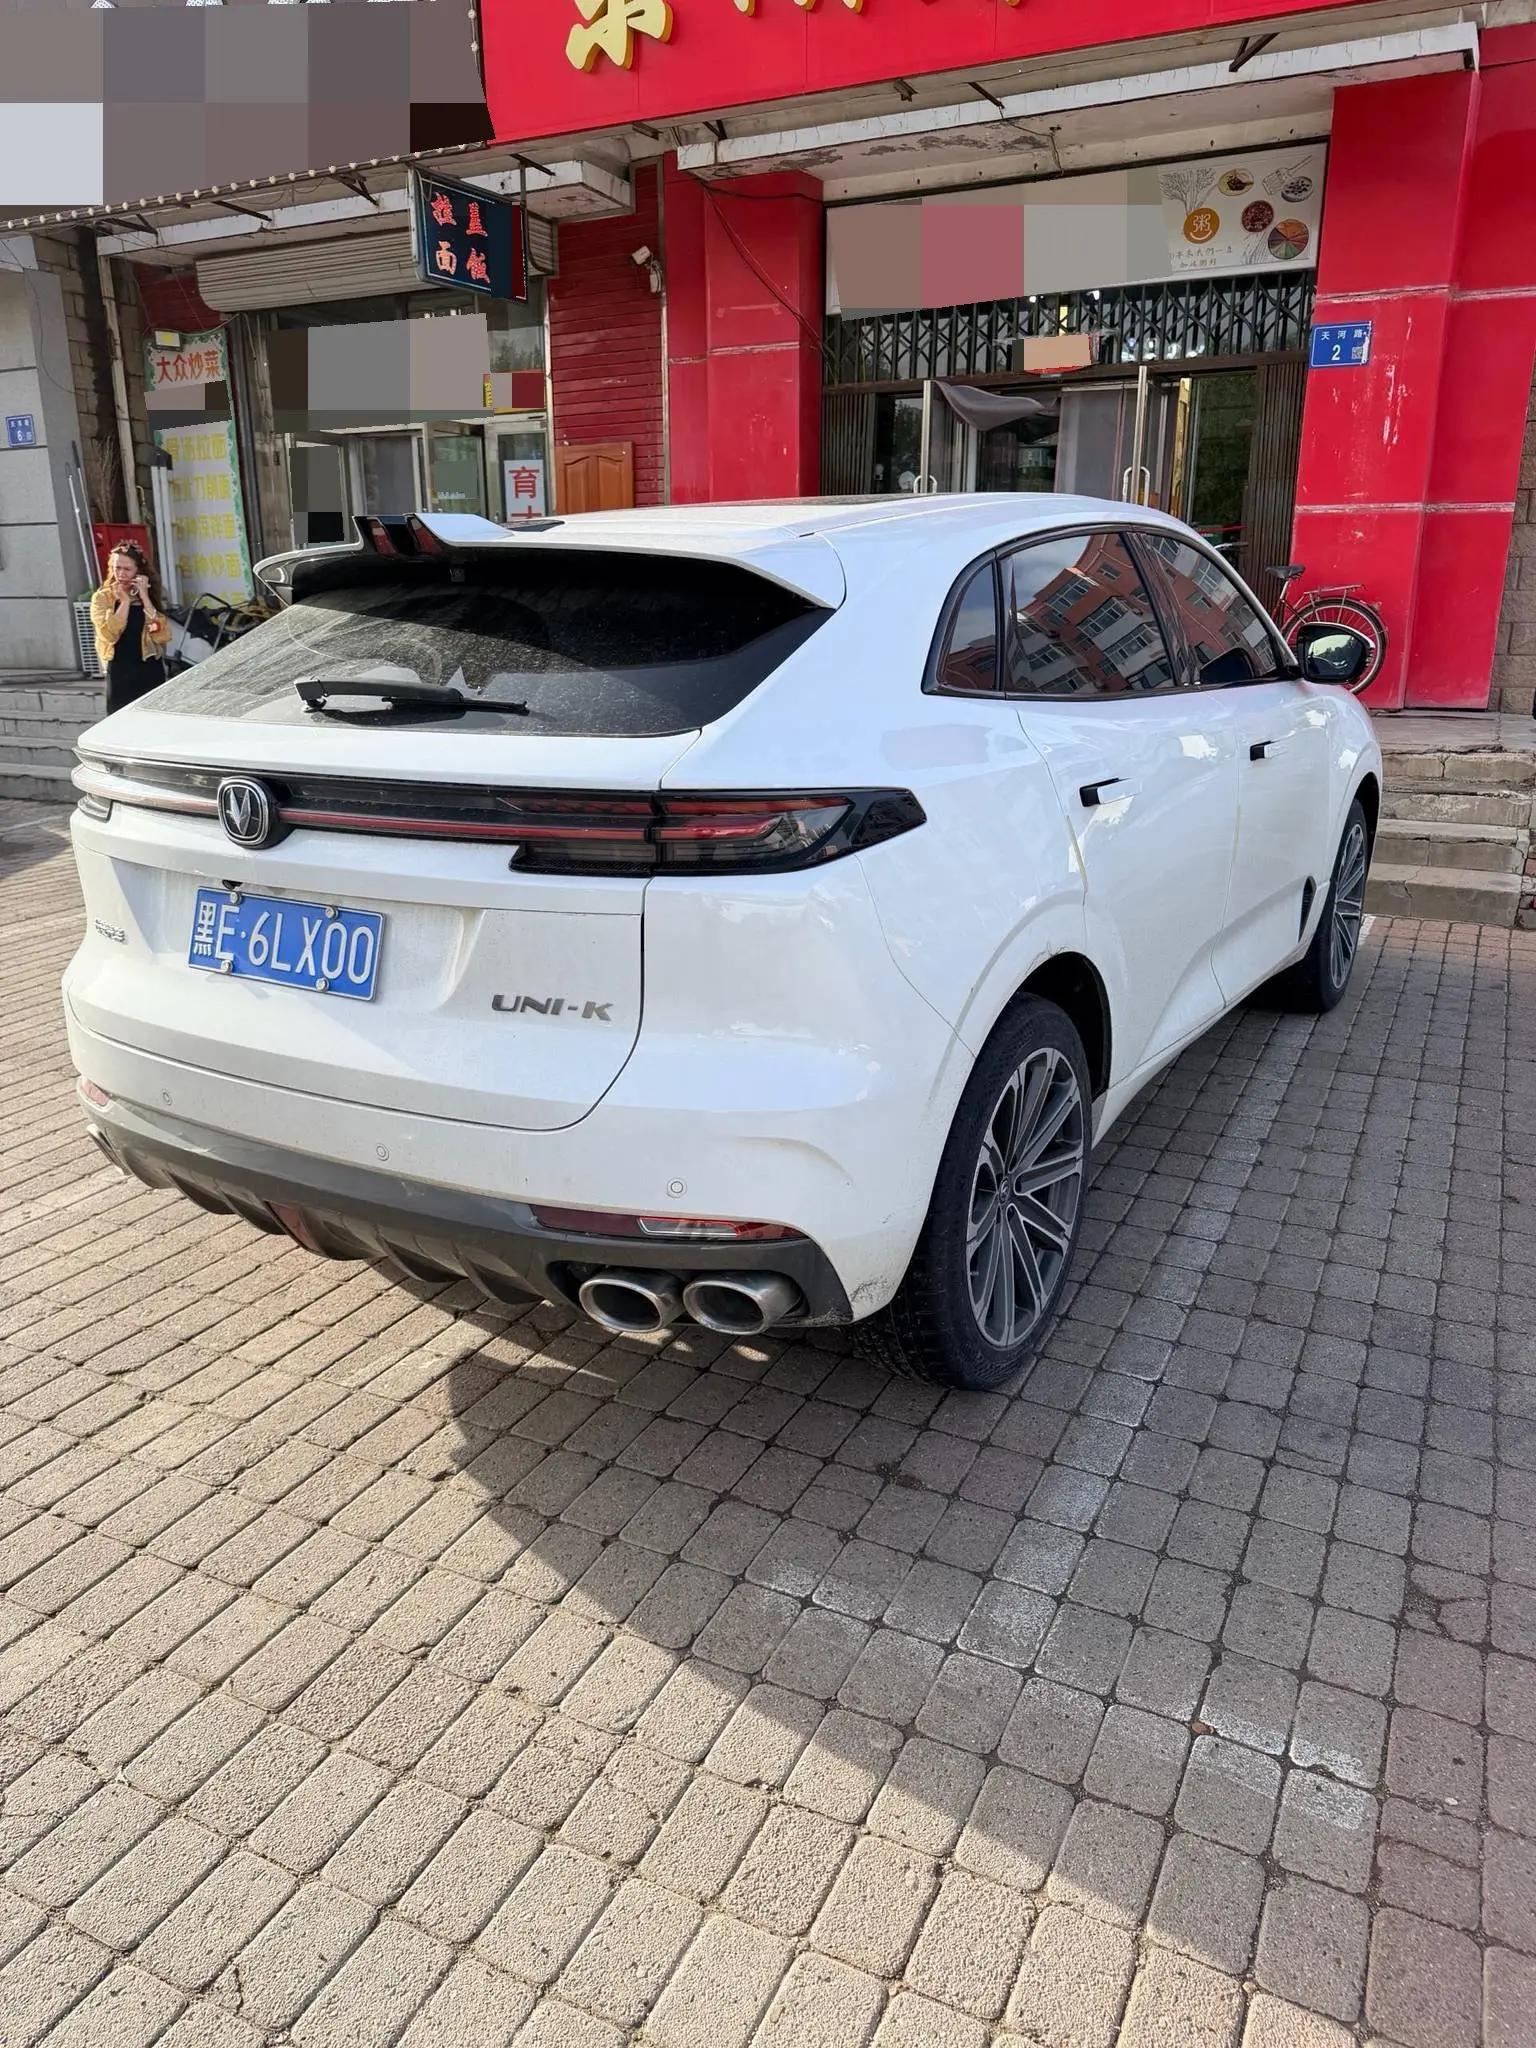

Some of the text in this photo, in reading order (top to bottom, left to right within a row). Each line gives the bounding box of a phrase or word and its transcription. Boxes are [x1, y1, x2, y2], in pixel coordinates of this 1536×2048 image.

[1192, 213, 1211, 233] 粥
[1321, 329, 1363, 340] 天河路
[1331, 344, 1341, 361] 2
[156, 350, 220, 384] 大众炒菜
[491, 994, 614, 1022] UNI-K
